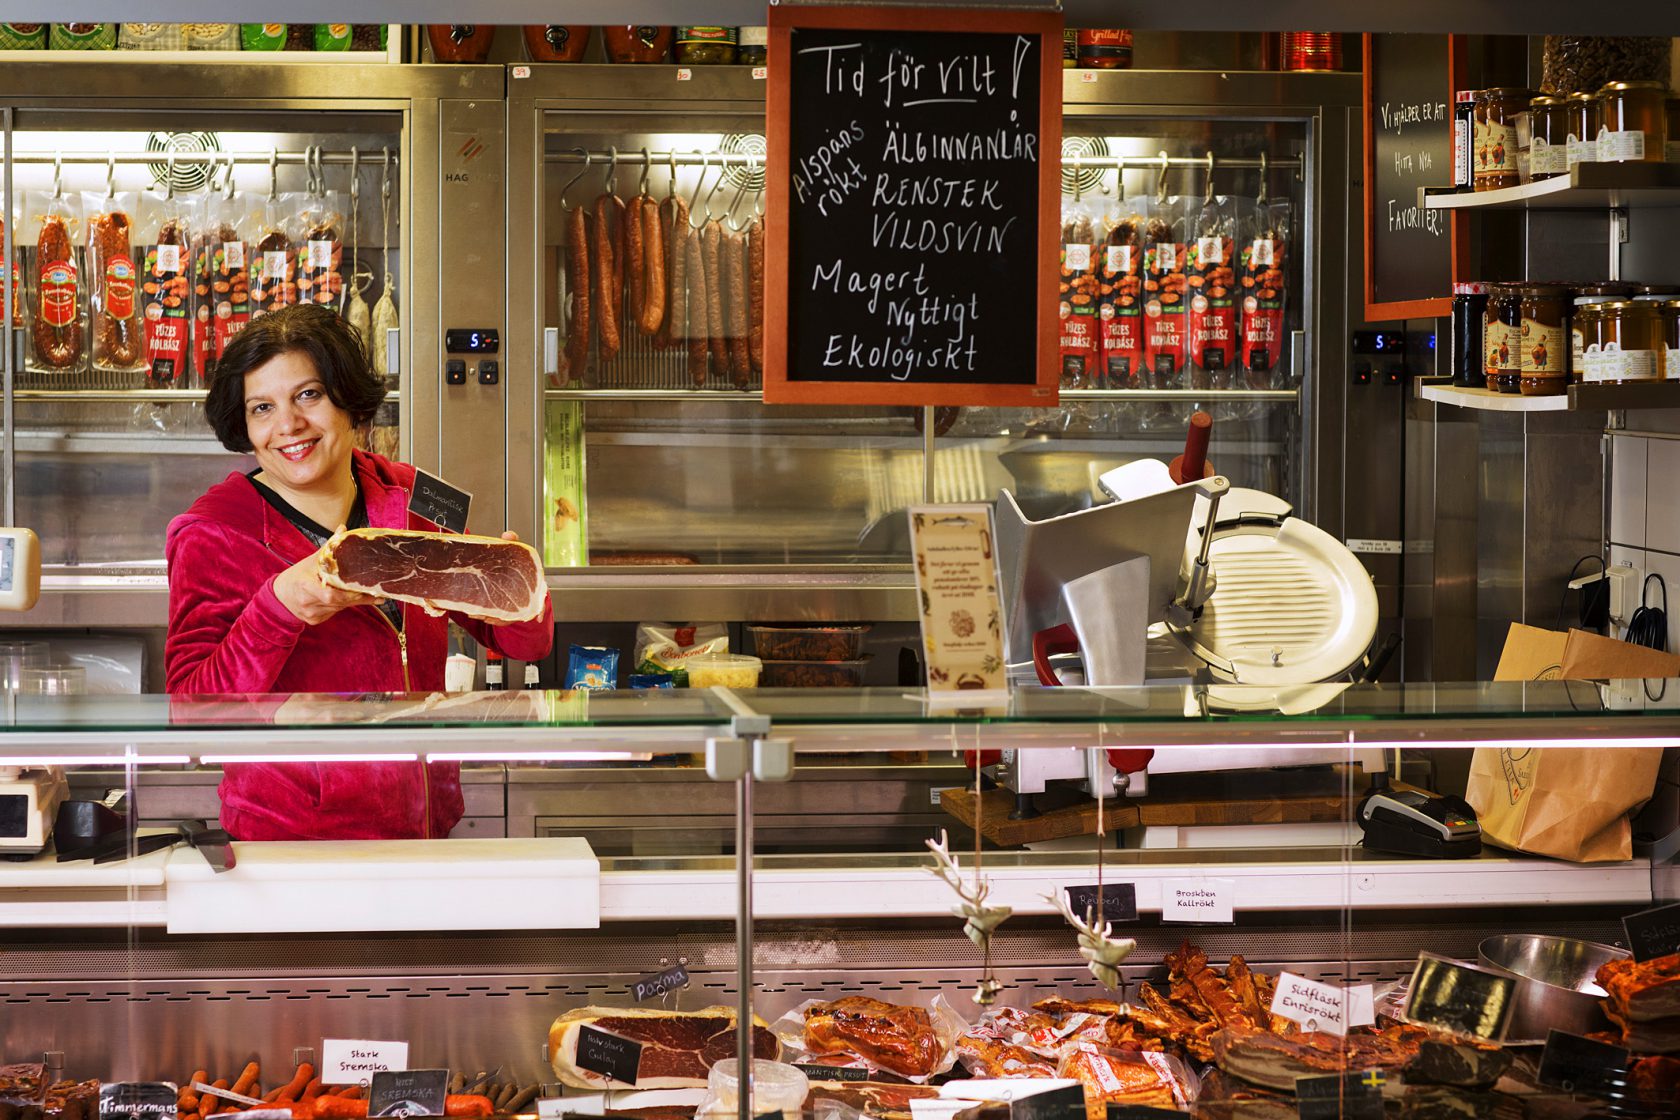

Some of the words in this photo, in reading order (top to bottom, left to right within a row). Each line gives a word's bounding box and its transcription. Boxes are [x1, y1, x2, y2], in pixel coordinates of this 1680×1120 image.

[798, 43, 864, 97] Tid
[879, 50, 925, 108] för
[446, 173, 469, 182] HAG
[872, 173, 1003, 210] RENSTEK
[873, 211, 1017, 253] VILDSVIN
[812, 259, 929, 314] Magert
[887, 293, 979, 346] Nyttigt
[470, 333, 479, 348] 5
[1375, 335, 1383, 349] 5
[823, 334, 977, 381] Ekologiskt
[1176, 889, 1216, 897] Broskben
[1177, 900, 1216, 908] Kallrökt
[1291, 984, 1341, 1008] Sidfläsk
[1282, 997, 1342, 1022] Enrisrökt
[351, 1050, 379, 1058] Stark
[340, 1061, 389, 1071] Sremska
[99, 1096, 178, 1114] Timmermans
